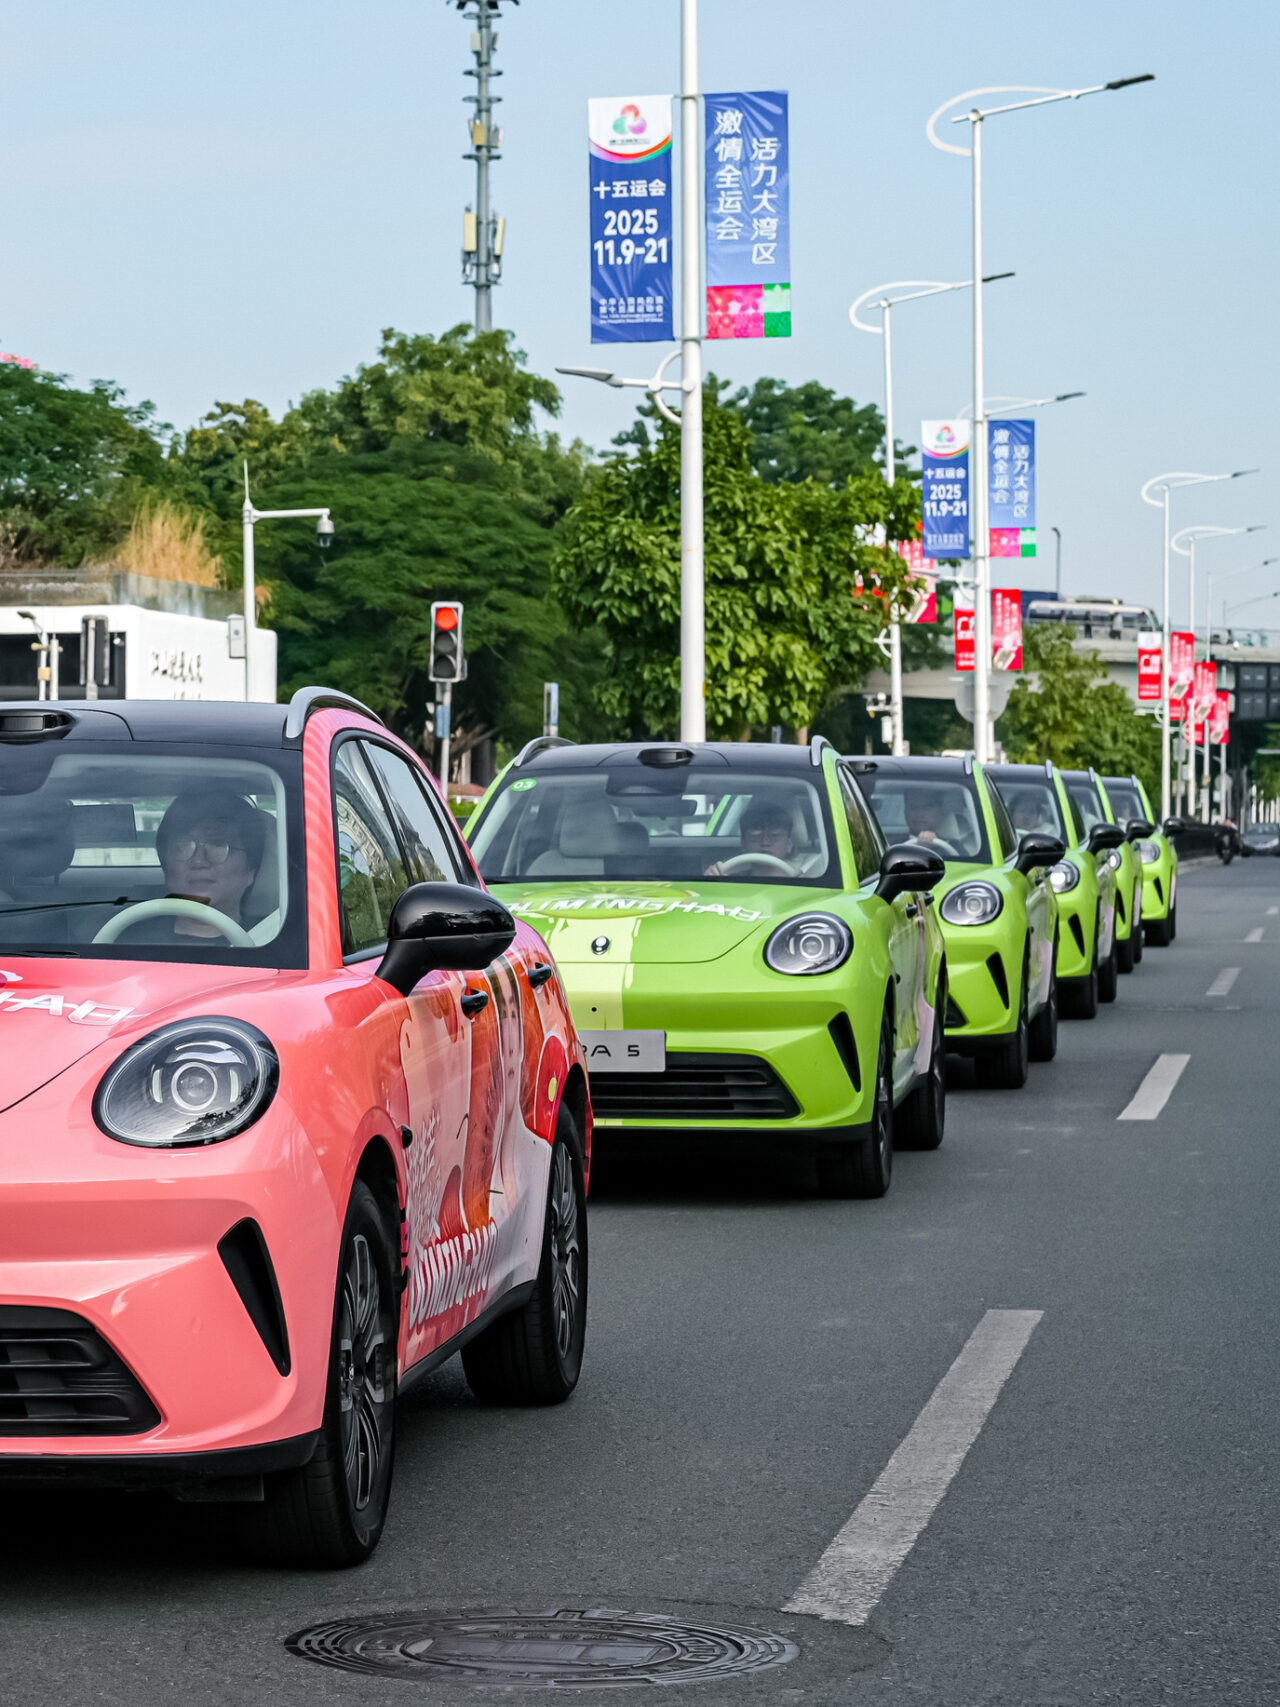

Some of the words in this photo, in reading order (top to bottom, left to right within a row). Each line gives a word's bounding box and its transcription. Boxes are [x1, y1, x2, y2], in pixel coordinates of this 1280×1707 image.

[714, 110, 743, 241] 激情全运会
[593, 178, 667, 200] 十五运会
[750, 137, 778, 265] 活力大湾区
[603, 209, 659, 236] 2025
[594, 238, 668, 266] 11.9-21
[930, 484, 962, 500] 2025
[924, 501, 967, 517] 11.9-21
[627, 1044, 640, 1057] 5
